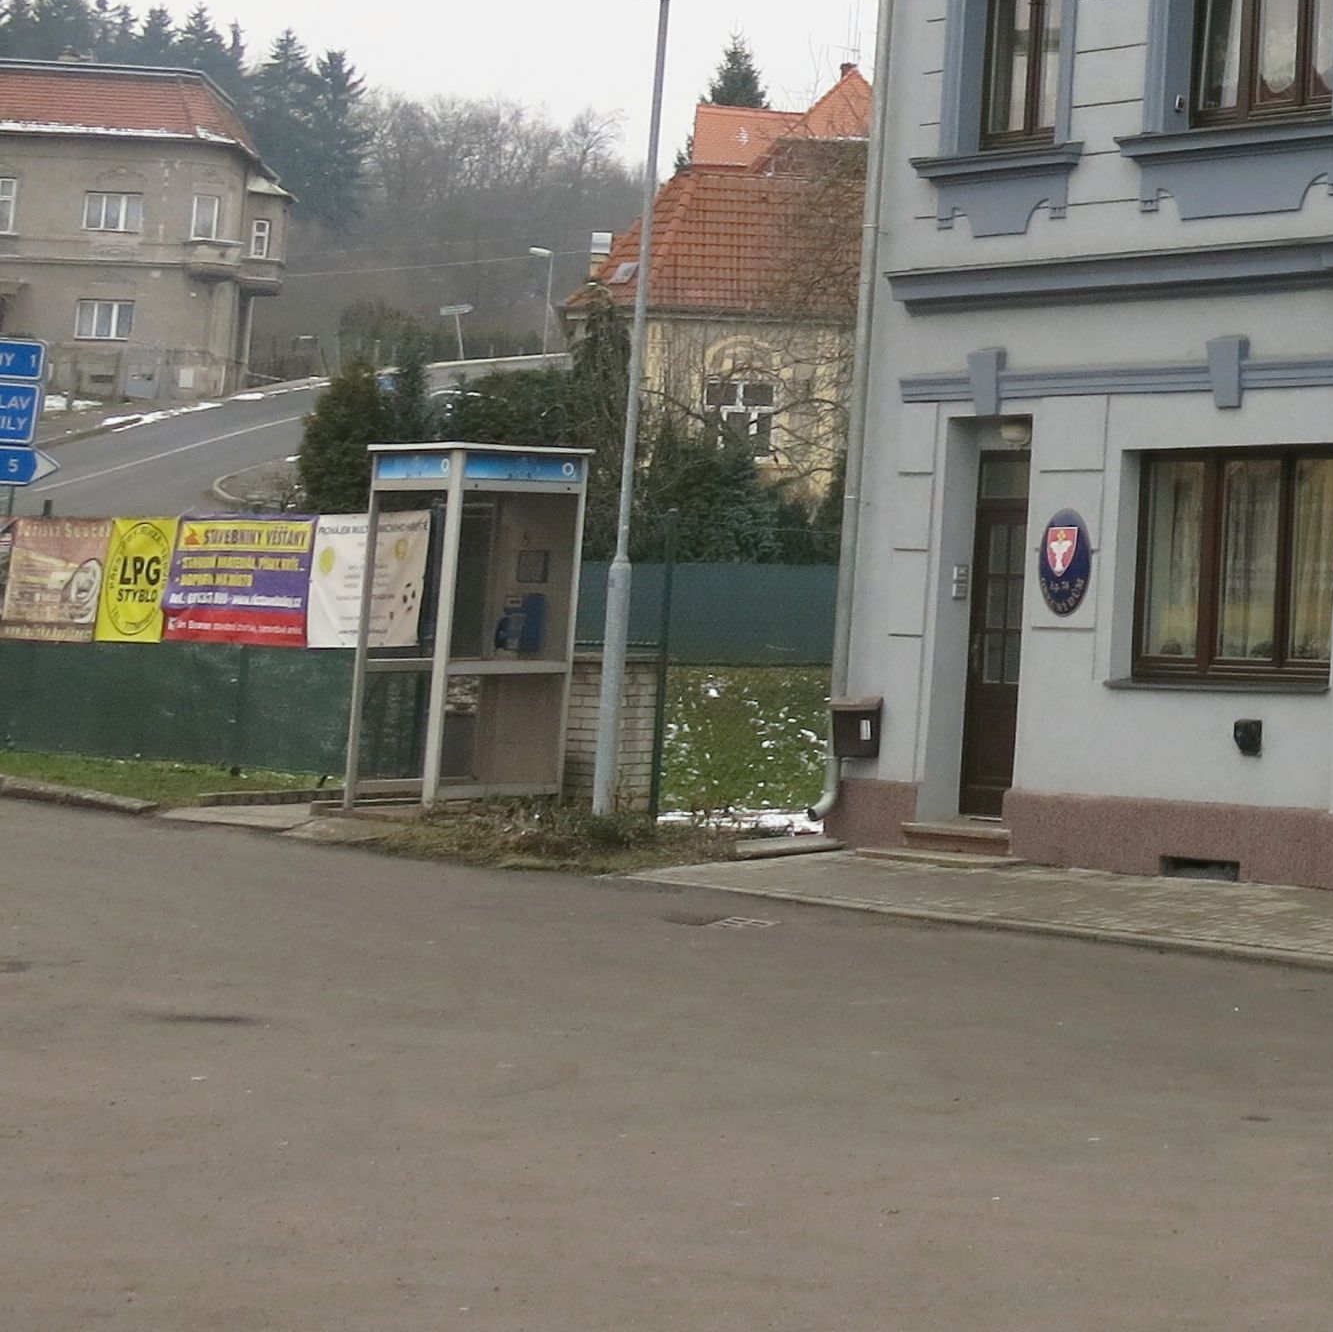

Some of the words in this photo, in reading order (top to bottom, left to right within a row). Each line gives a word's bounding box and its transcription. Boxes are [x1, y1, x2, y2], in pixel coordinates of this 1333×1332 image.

[31, 354, 37, 368] 1
[0, 415, 28, 431] ILY
[8, 459, 19, 473] 5
[119, 555, 161, 586] LPG
